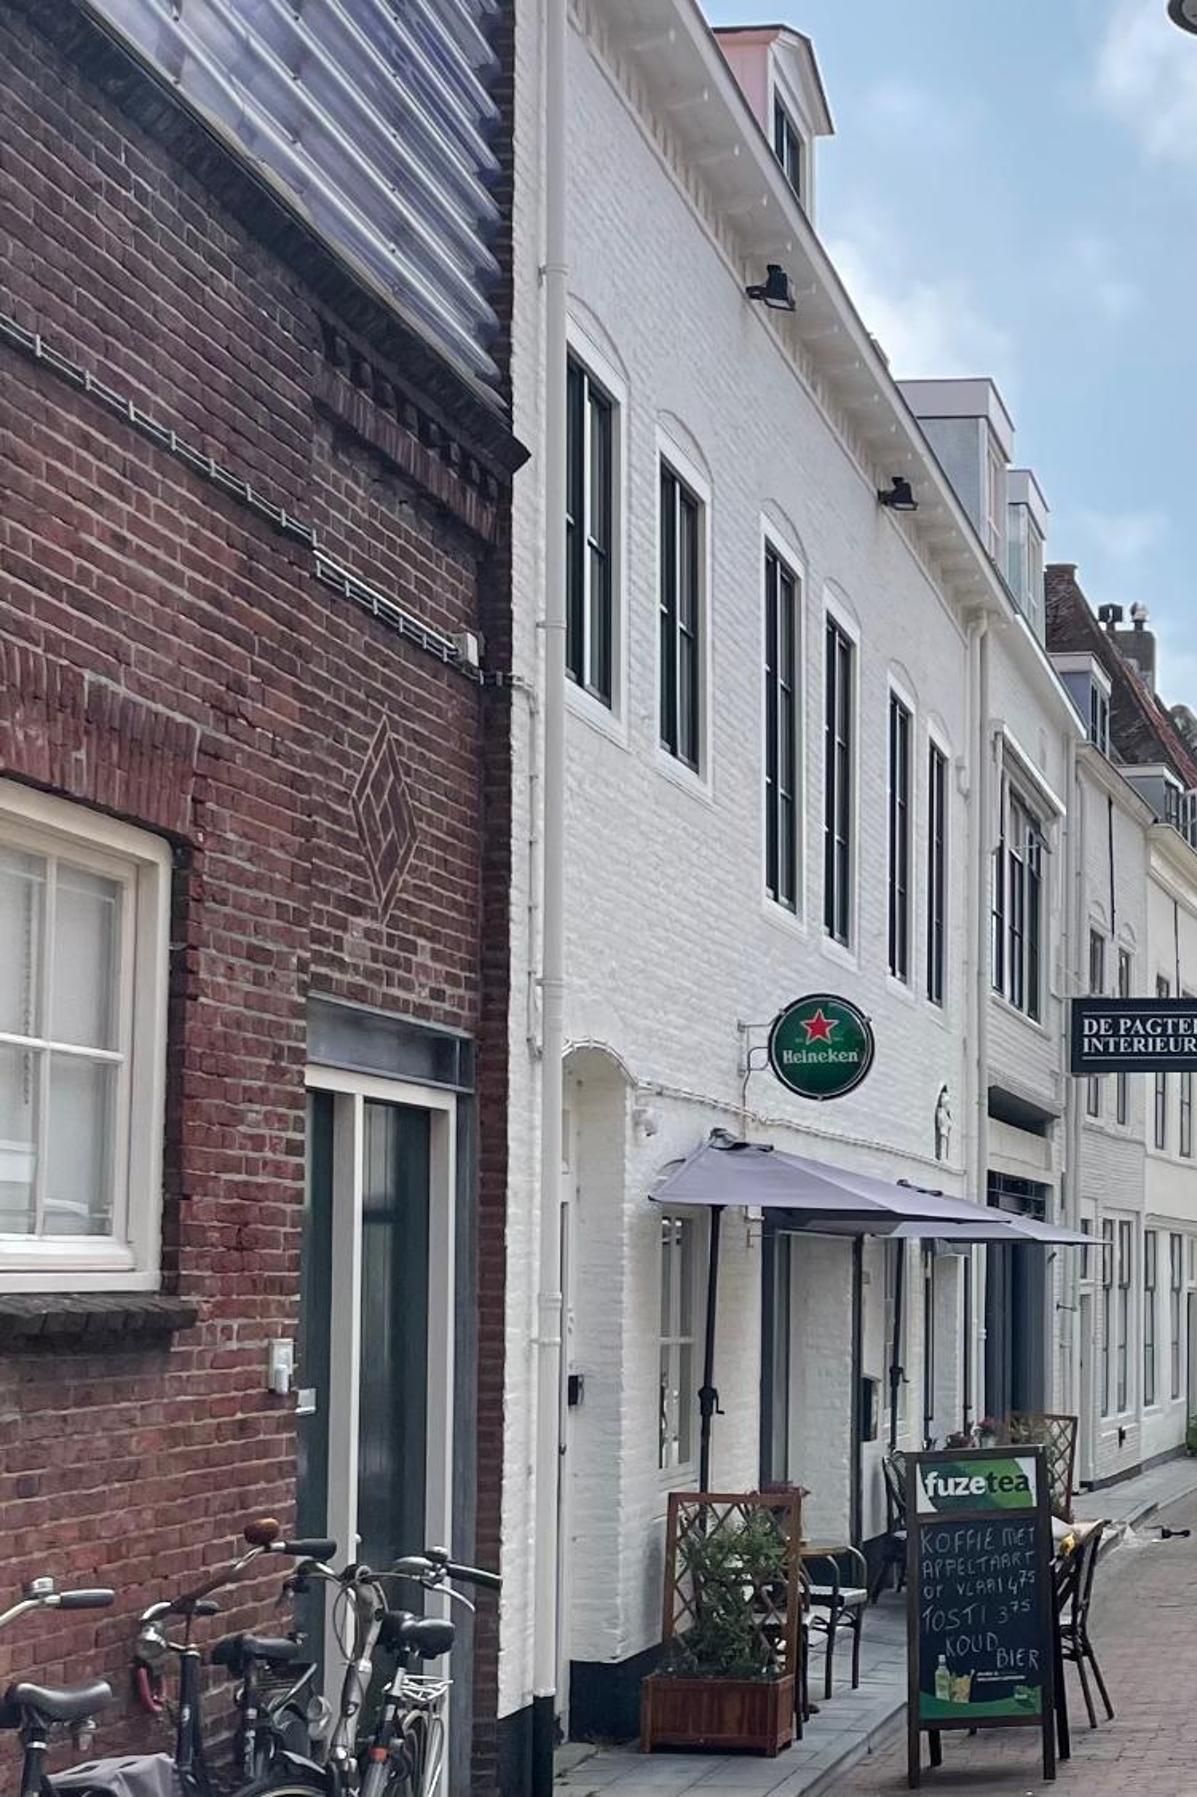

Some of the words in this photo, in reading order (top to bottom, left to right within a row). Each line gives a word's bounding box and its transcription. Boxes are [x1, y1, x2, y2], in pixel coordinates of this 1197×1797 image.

[1083, 1018, 1113, 1035] DE
[782, 1048, 859, 1064] Heineken
[920, 1527, 995, 1554] KOFFIE
[1002, 1526, 1036, 1546] MET
[957, 1578, 1003, 1596] VLAAI
[922, 1602, 986, 1635] TOSTI
[945, 1631, 998, 1657] KOUD
[997, 1648, 1040, 1671] BIER
